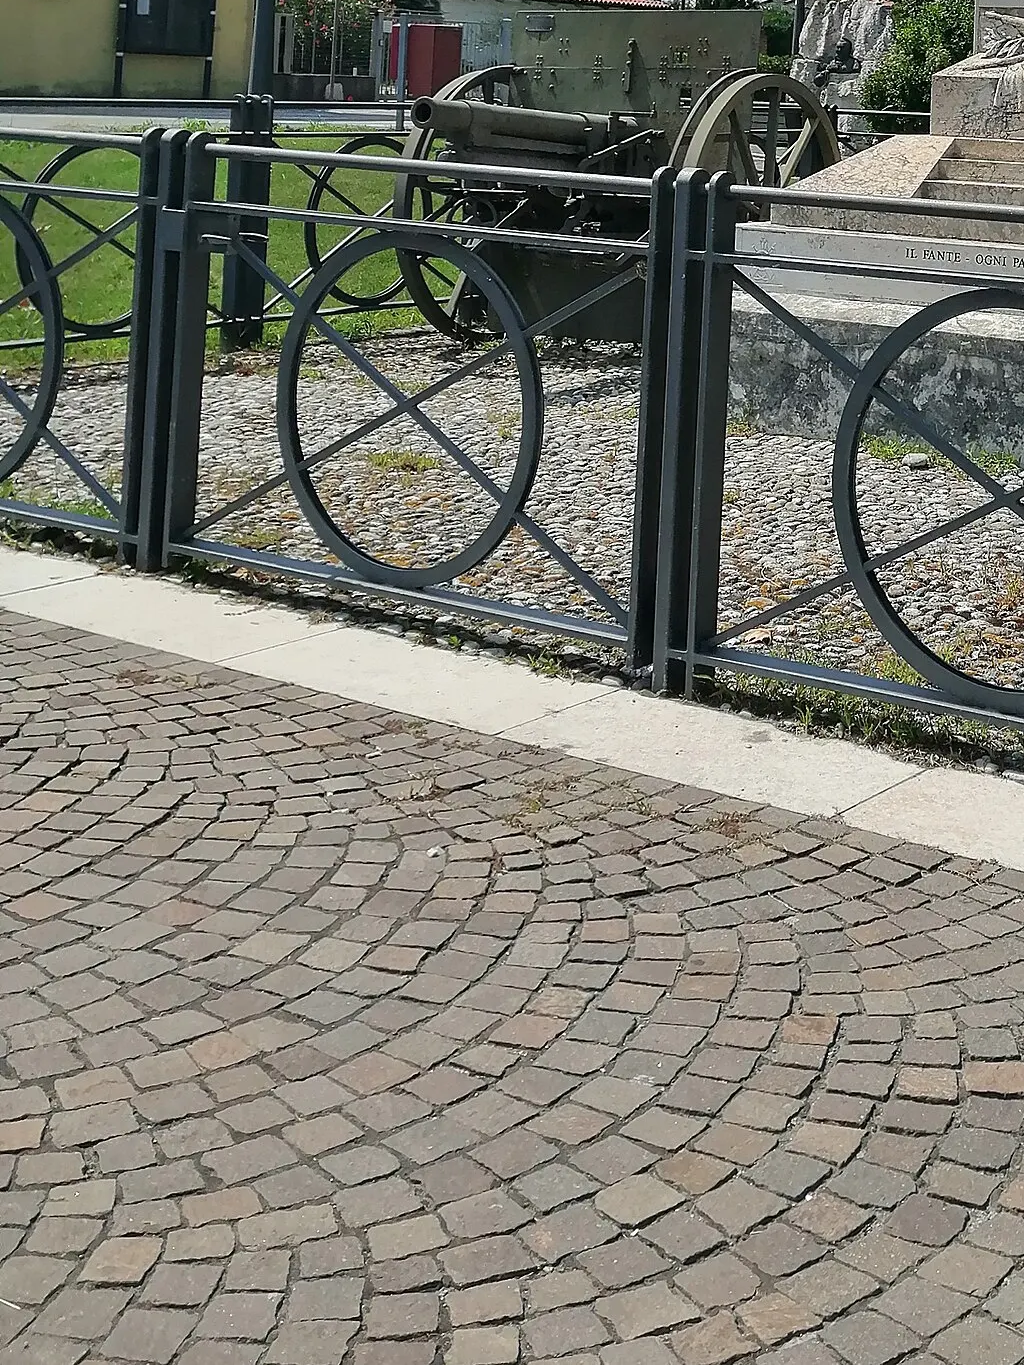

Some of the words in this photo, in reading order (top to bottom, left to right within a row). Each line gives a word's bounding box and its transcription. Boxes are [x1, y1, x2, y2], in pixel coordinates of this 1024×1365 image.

[905, 248, 918, 259] IL
[923, 249, 961, 263] FANTE
[975, 254, 1007, 267] OGNI
